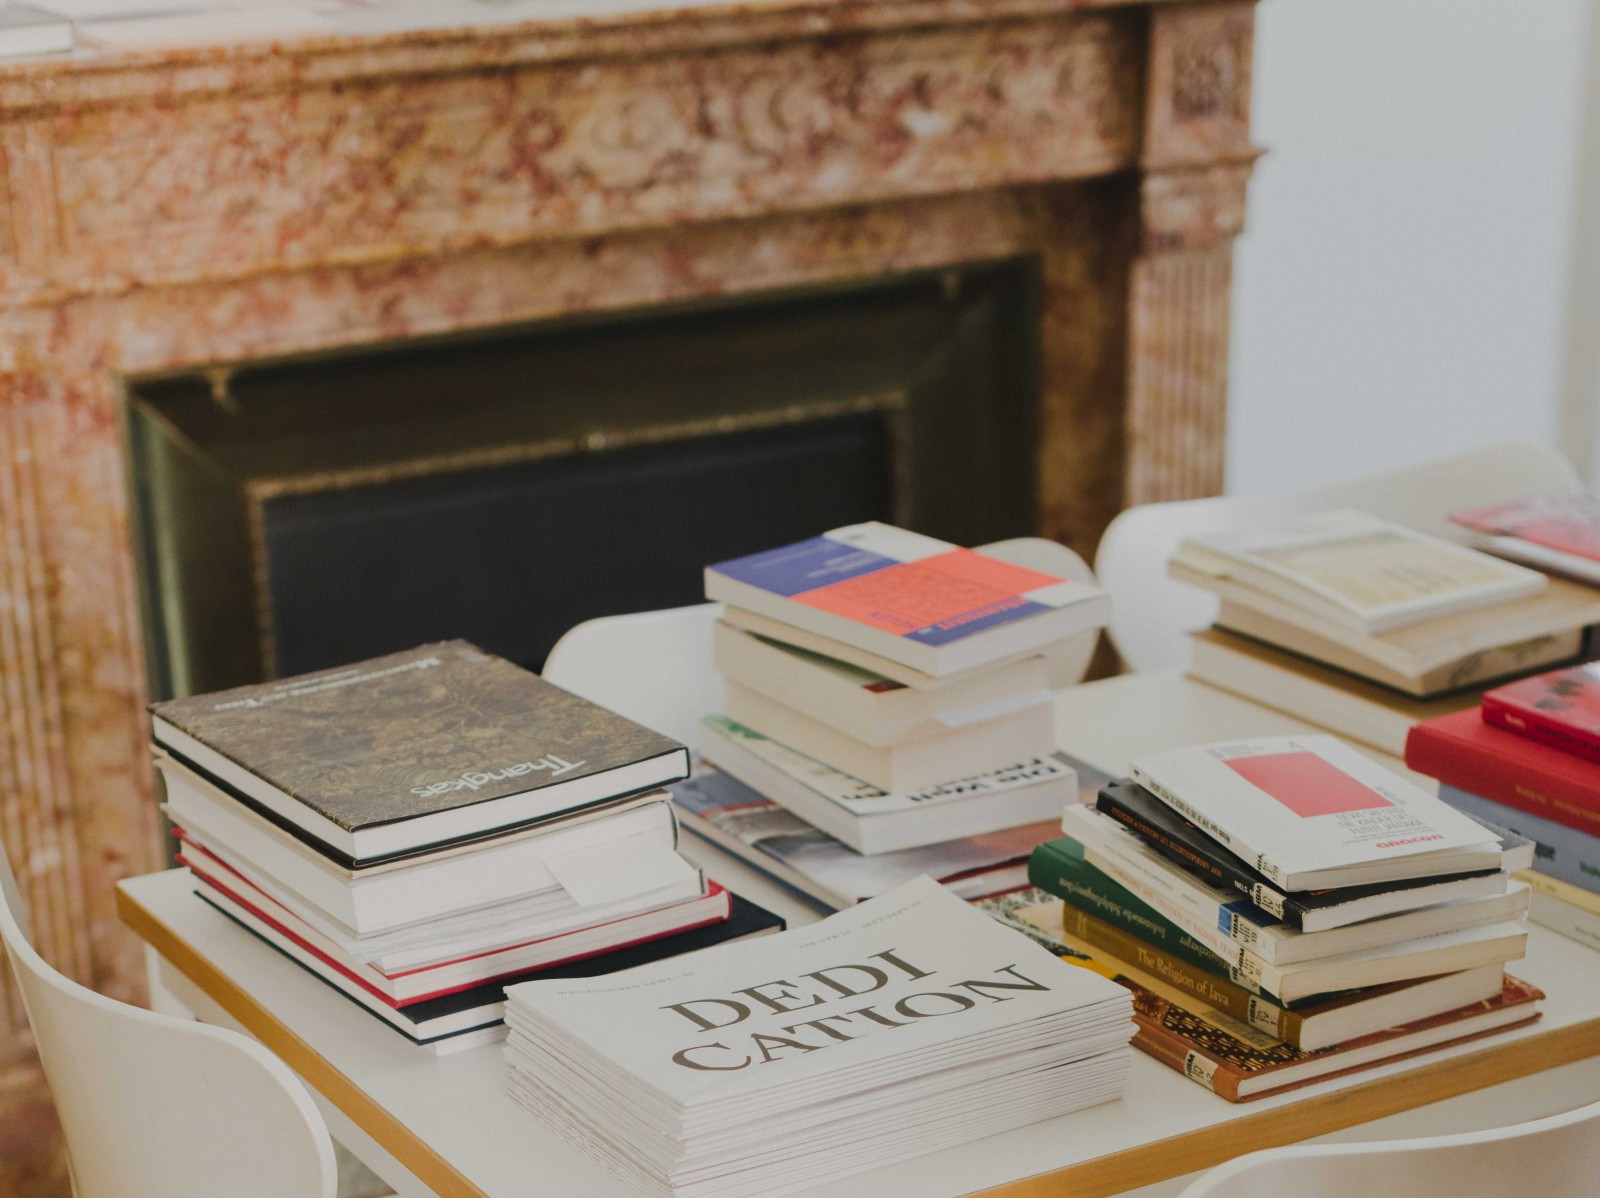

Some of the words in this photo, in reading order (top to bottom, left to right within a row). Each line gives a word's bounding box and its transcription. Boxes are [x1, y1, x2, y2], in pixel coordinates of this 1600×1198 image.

[410, 754, 586, 797] Thangkas
[643, 977, 675, 987] NEWS
[659, 948, 937, 1032] DEDI
[1136, 947, 1155, 967] The
[1156, 957, 1195, 987] Religion
[1196, 978, 1208, 995] of
[1208, 983, 1230, 1007] Java
[672, 964, 1052, 1071] CATION
[1249, 999, 1257, 1024] HBM
[1186, 1053, 1196, 1079] HBM
